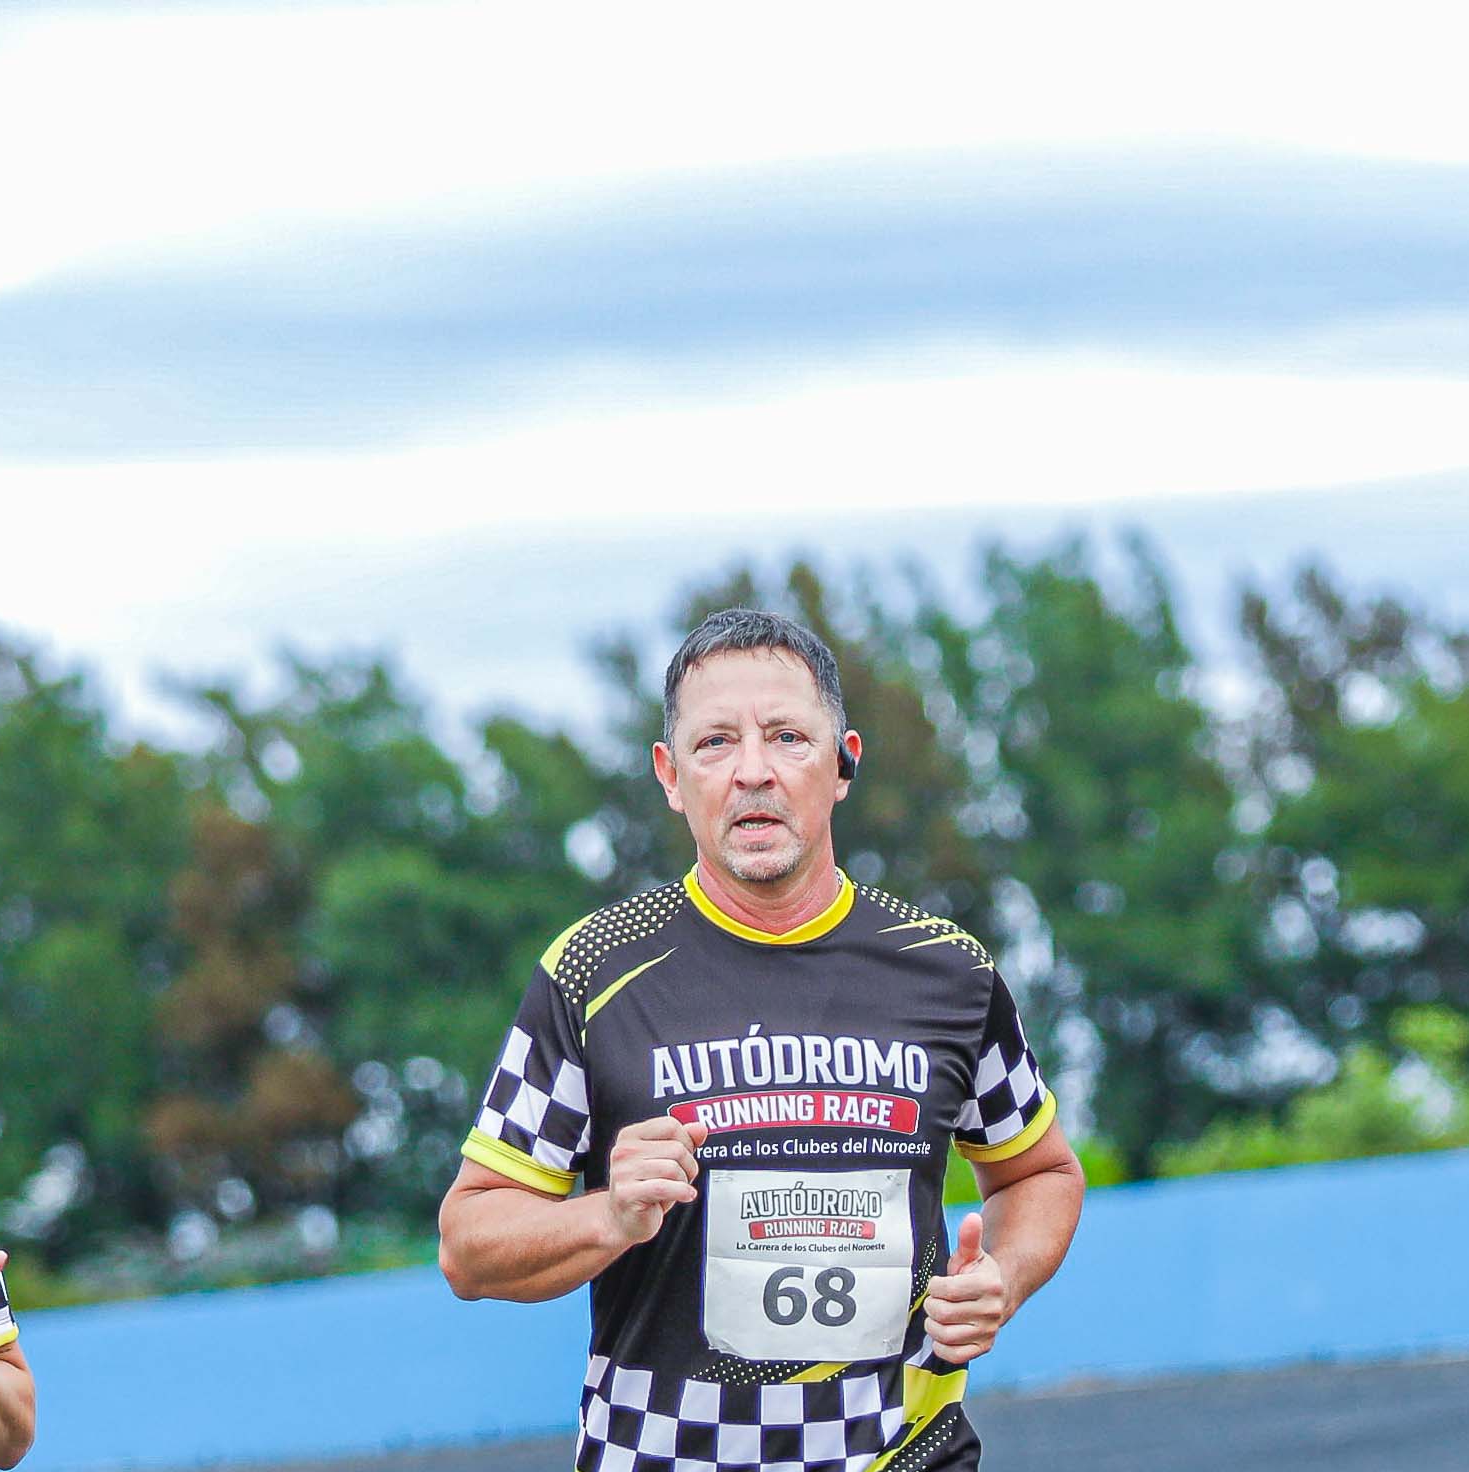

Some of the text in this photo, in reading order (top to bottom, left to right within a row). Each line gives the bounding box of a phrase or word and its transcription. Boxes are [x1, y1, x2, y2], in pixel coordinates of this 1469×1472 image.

[652, 1023, 930, 1099] AUTÓDROMO
[695, 1094, 894, 1130] RUNNING RACE
[697, 1137, 931, 1159] rera de los Clubes del Noroeste
[740, 1181, 882, 1219] AUTÓDROMO
[764, 1220, 863, 1237] RUNNING RACE
[736, 1242, 886, 1253] La Carrera de los Clubes del Noroeste
[763, 1266, 857, 1327] 68
